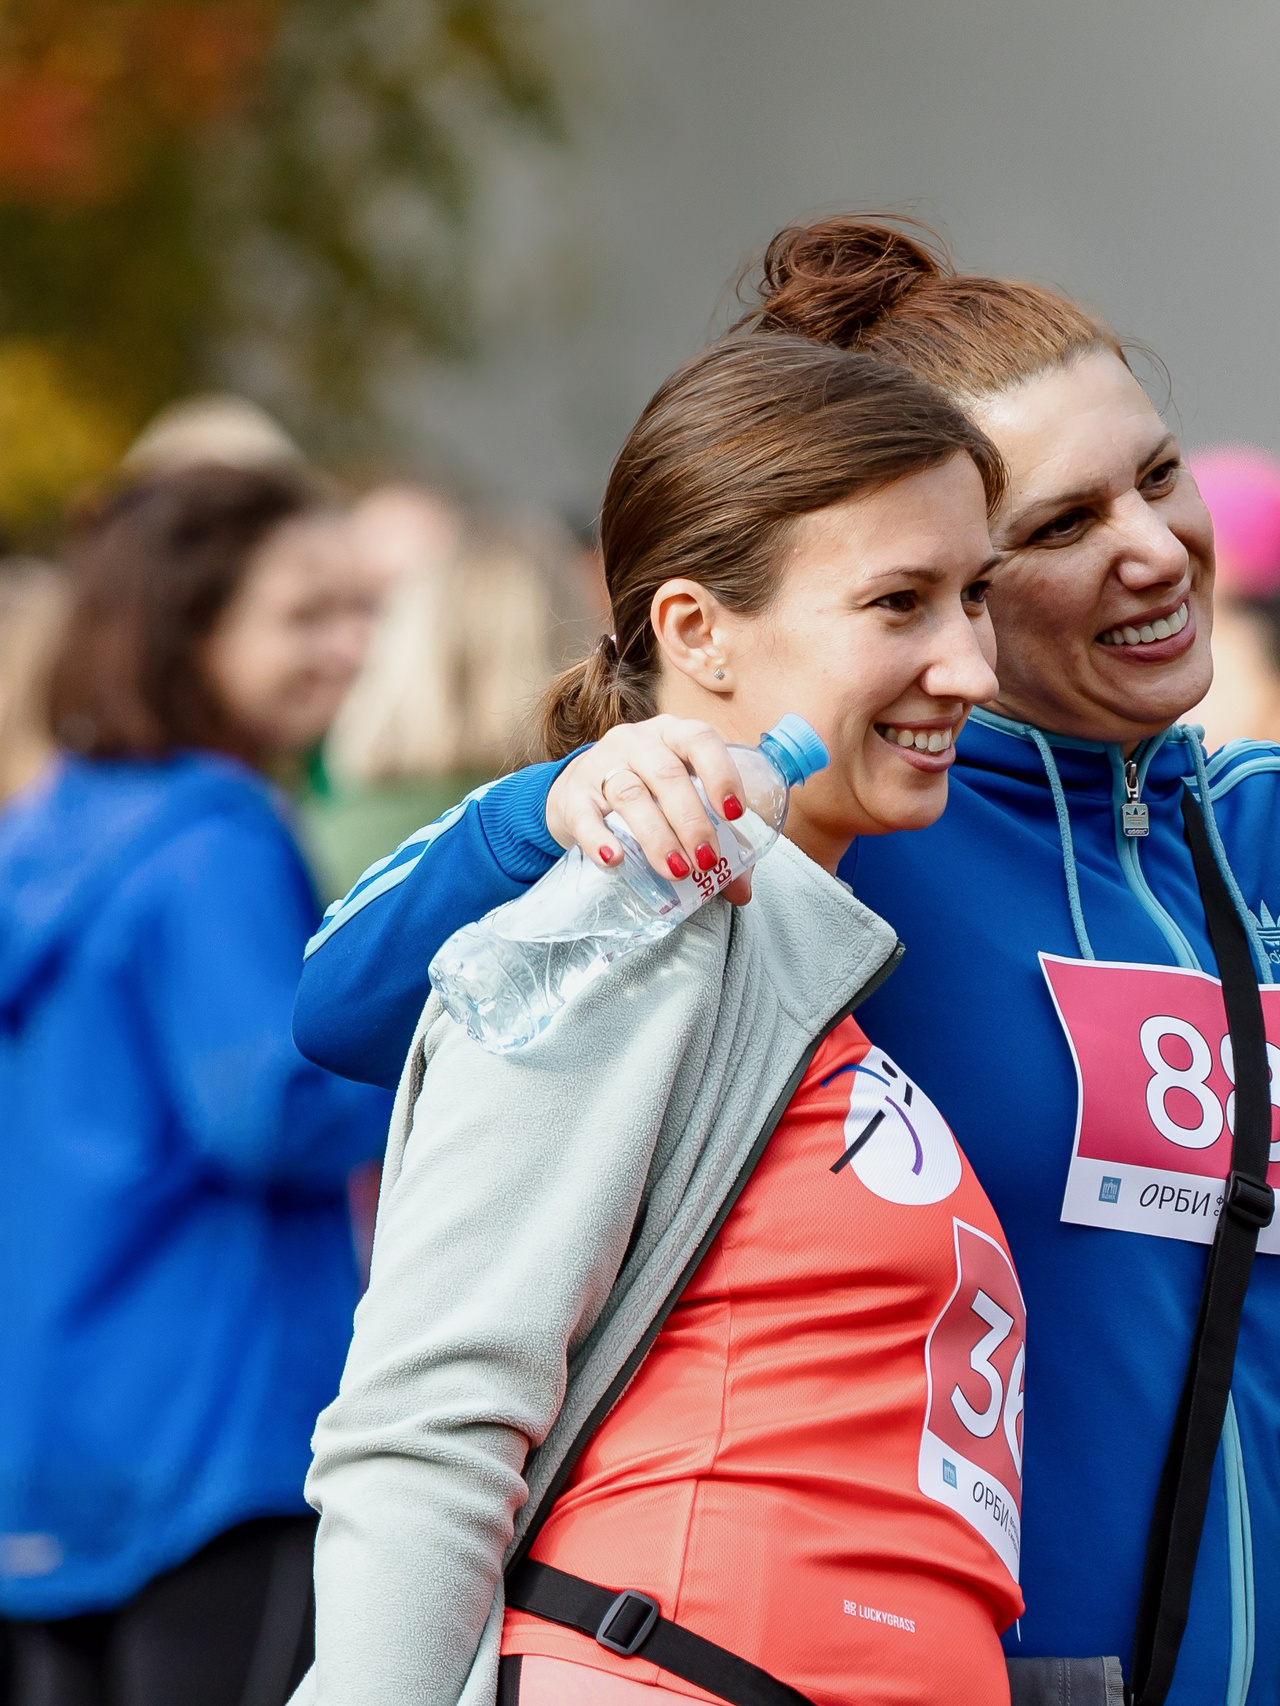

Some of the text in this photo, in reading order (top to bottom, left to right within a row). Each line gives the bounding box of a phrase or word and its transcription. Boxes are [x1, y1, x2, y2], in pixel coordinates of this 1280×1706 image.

[1139, 1183, 1211, 1217] ОРБИ
[972, 1481, 1010, 1533] ОРБИ
[858, 1604, 916, 1634] LUCKYGRASS
